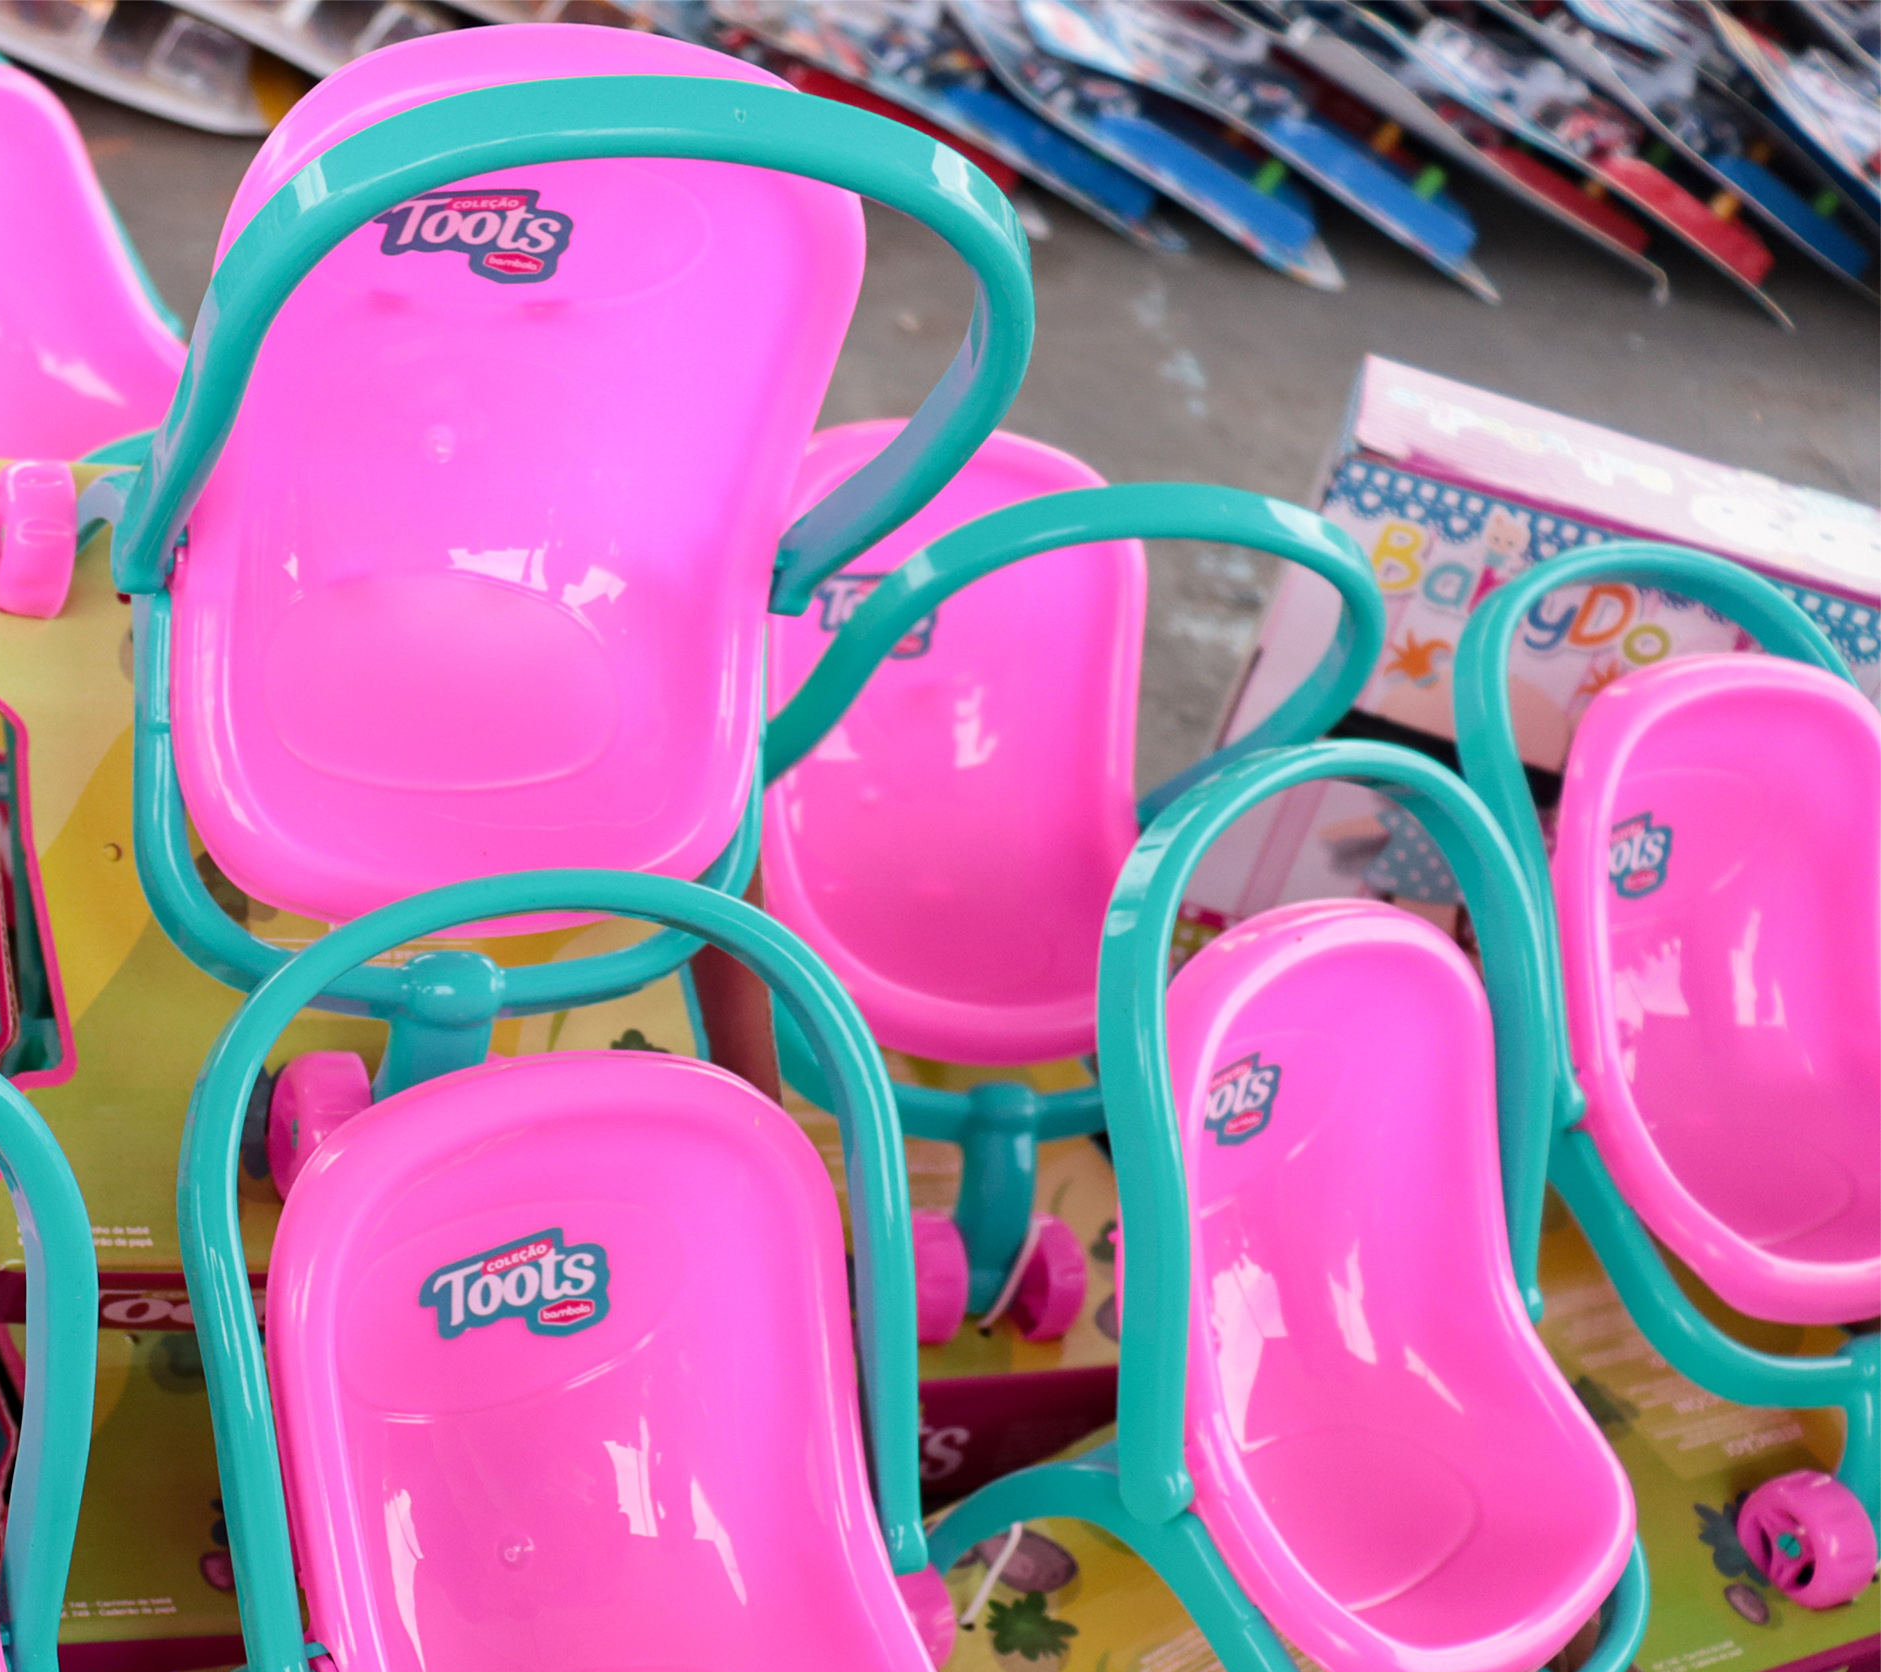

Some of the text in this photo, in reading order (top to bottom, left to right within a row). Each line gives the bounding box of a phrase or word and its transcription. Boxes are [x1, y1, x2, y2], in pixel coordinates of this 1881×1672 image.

[452, 196, 519, 211] COLEÇÃO
[391, 198, 562, 253] Toots
[488, 256, 538, 271] bambola
[486, 1243, 547, 1273] COLEÇÃO
[432, 1248, 596, 1326] Toots
[542, 1304, 591, 1320] bambola
